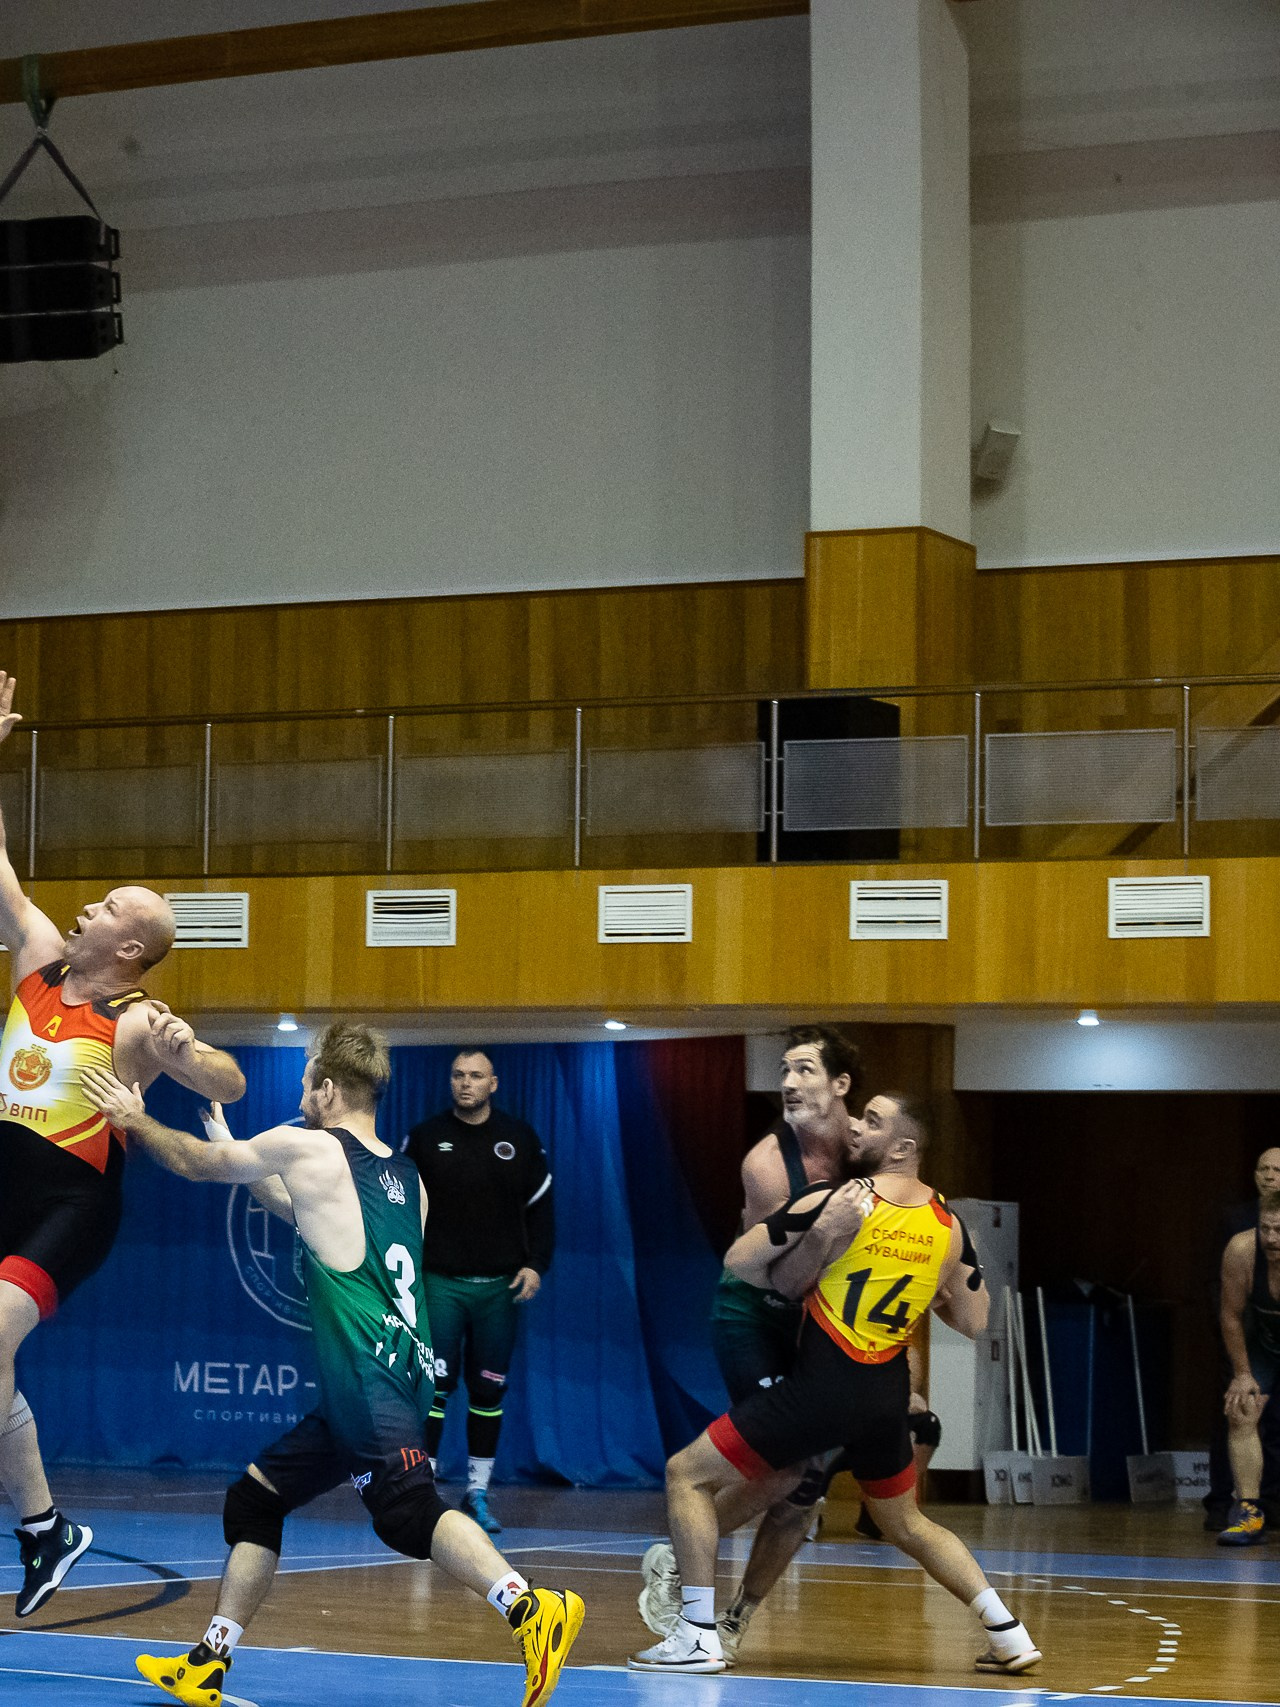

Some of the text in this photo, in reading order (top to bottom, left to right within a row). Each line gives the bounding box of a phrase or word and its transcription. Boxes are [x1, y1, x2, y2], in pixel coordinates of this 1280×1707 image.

[9, 1103, 48, 1122] ВПП
[871, 1228, 934, 1248] СБОРНАЯ
[384, 1242, 417, 1329] 3
[842, 1267, 915, 1334] 14
[193, 1408, 305, 1424] СПОРТИВН
